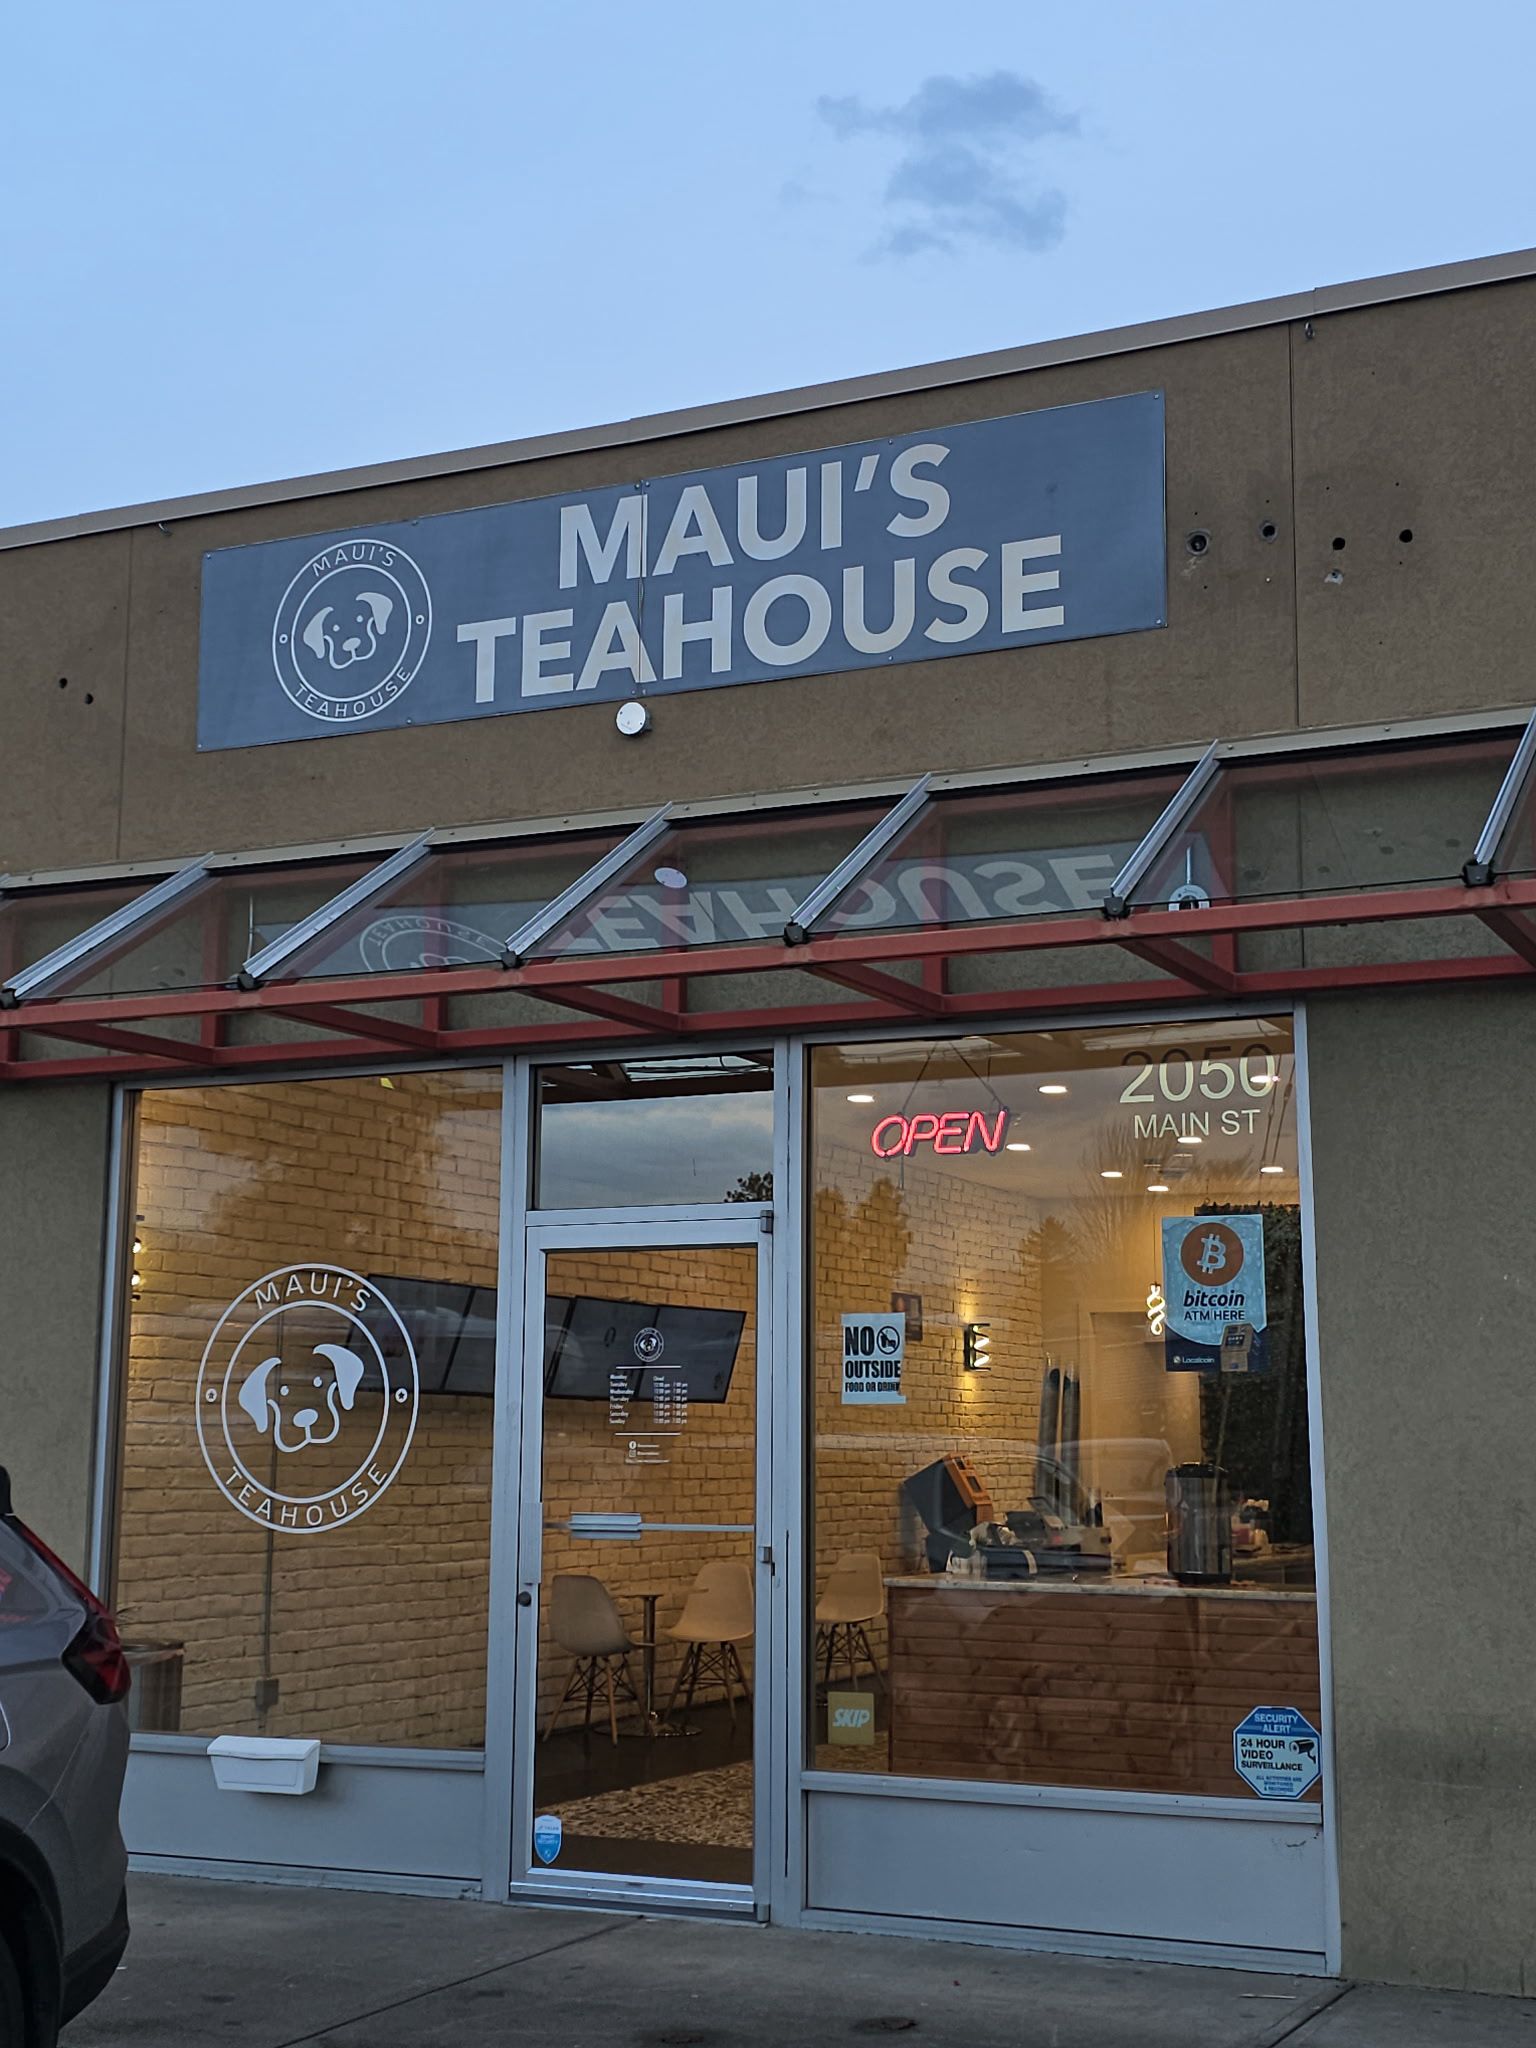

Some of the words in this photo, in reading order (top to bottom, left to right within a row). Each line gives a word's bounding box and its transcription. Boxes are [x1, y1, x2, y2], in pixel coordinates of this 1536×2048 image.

[559, 443, 951, 589] MAUI'S
[312, 544, 397, 577] MAUI'S
[456, 534, 1065, 704] TEAHOUSE
[293, 666, 411, 718] TEAHOUSE
[1119, 1043, 1276, 1103] 2050
[870, 1106, 1010, 1160] OPEN
[1133, 1111, 1210, 1140] MAIN
[1221, 1109, 1262, 1135] ST
[254, 1271, 372, 1312] MAUI'S
[1183, 1289, 1245, 1307] bitcoin
[1184, 1310, 1211, 1321] ATM
[1213, 1310, 1245, 1320] HERE
[845, 1325, 875, 1356] NO
[845, 1360, 901, 1379] OUTSIDE
[845, 1381, 864, 1393] FOOD
[865, 1381, 876, 1393] OR
[224, 1462, 388, 1527] TEAHOUSE
[832, 1707, 871, 1729] SKIP
[1254, 1713, 1299, 1724] SECURITY
[1262, 1724, 1292, 1734] ALERT
[1240, 1738, 1253, 1747] 24
[1256, 1739, 1286, 1749] HOUR
[1240, 1749, 1274, 1760] VIDEO
[1240, 1760, 1304, 1771] SURVEILLANCE
